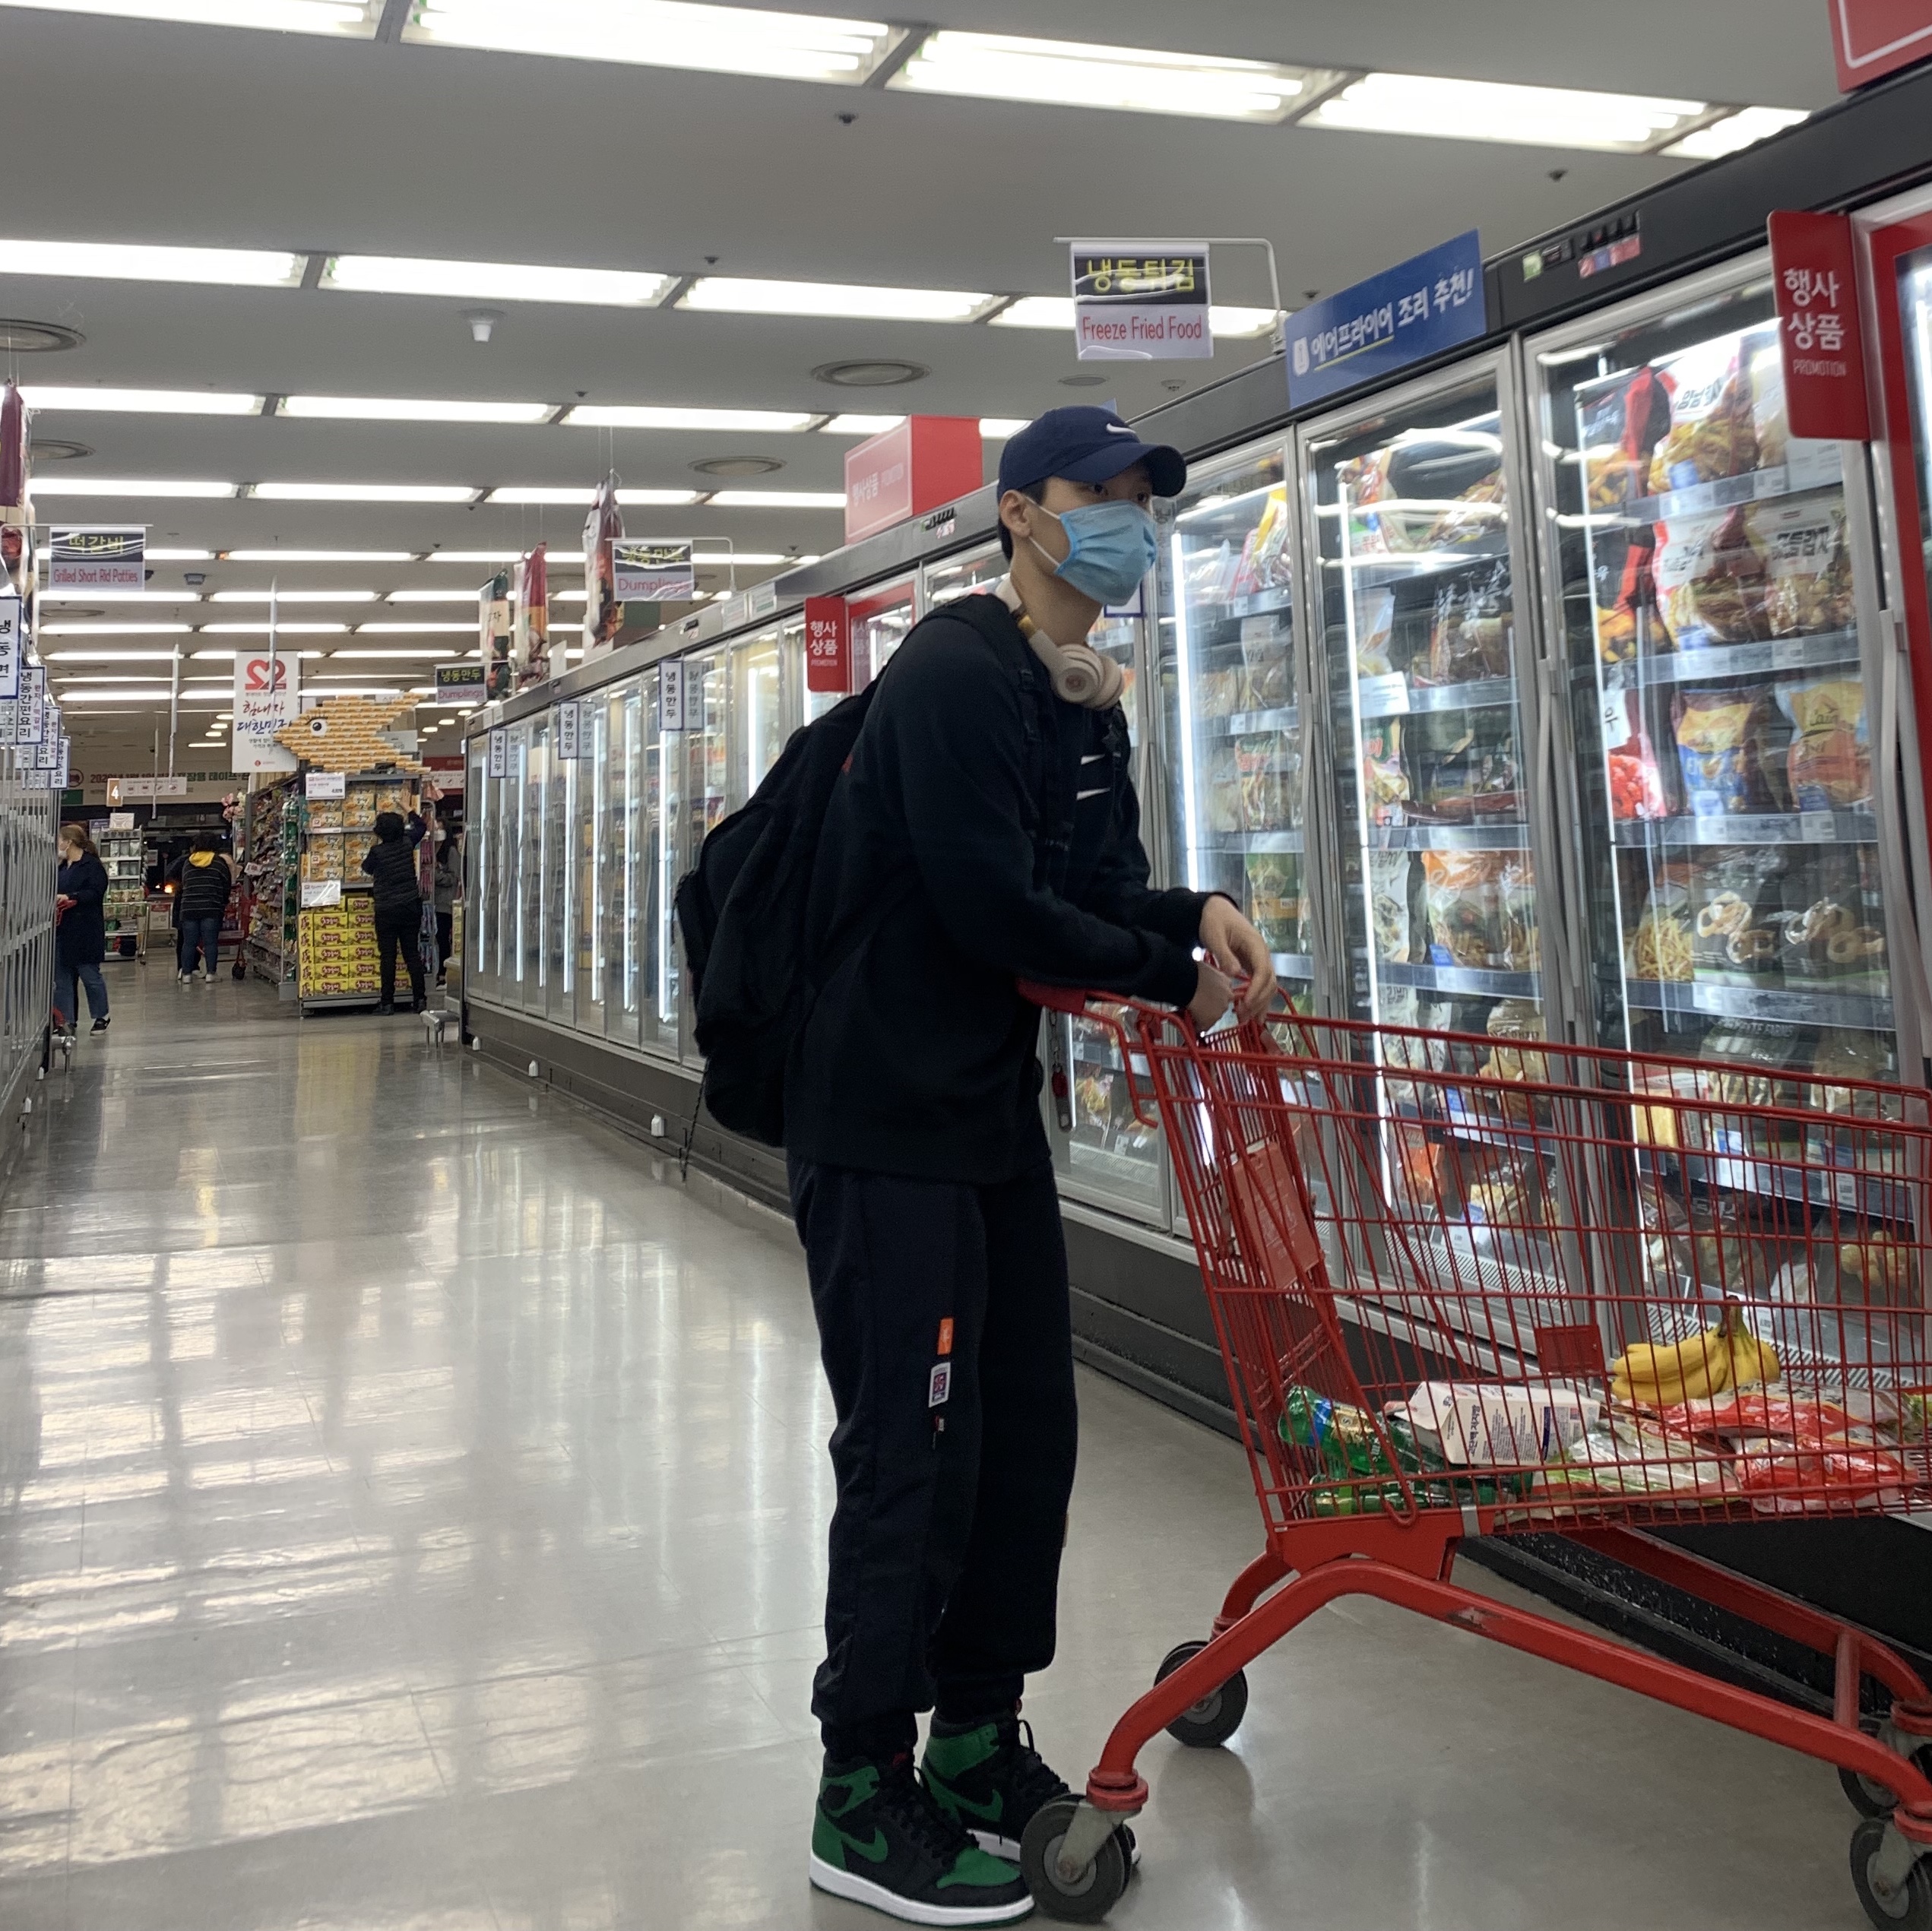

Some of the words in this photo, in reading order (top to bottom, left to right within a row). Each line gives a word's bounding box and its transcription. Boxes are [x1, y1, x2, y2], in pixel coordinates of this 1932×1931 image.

[1088, 258, 1196, 292] 냉동튀김
[1783, 268, 1840, 309] 행사
[1310, 302, 1395, 362] 에어프라이어
[1398, 286, 1430, 328] 조리
[1433, 267, 1475, 313] 추천!
[1082, 316, 1127, 340] Freeze
[1131, 315, 1164, 339] Fried
[1168, 315, 1202, 339] Food
[1787, 312, 1845, 351] 상품
[1792, 358, 1847, 378] PROMOTION
[69, 535, 125, 555] 떡갈비
[54, 569, 76, 583] Grilled
[78, 569, 98, 583] Short
[809, 620, 838, 638] 행사
[809, 639, 838, 656] 상품
[441, 669, 482, 683] 냉동만두
[438, 688, 484, 700] Dumplings
[665, 672, 676, 718] 냉동만두
